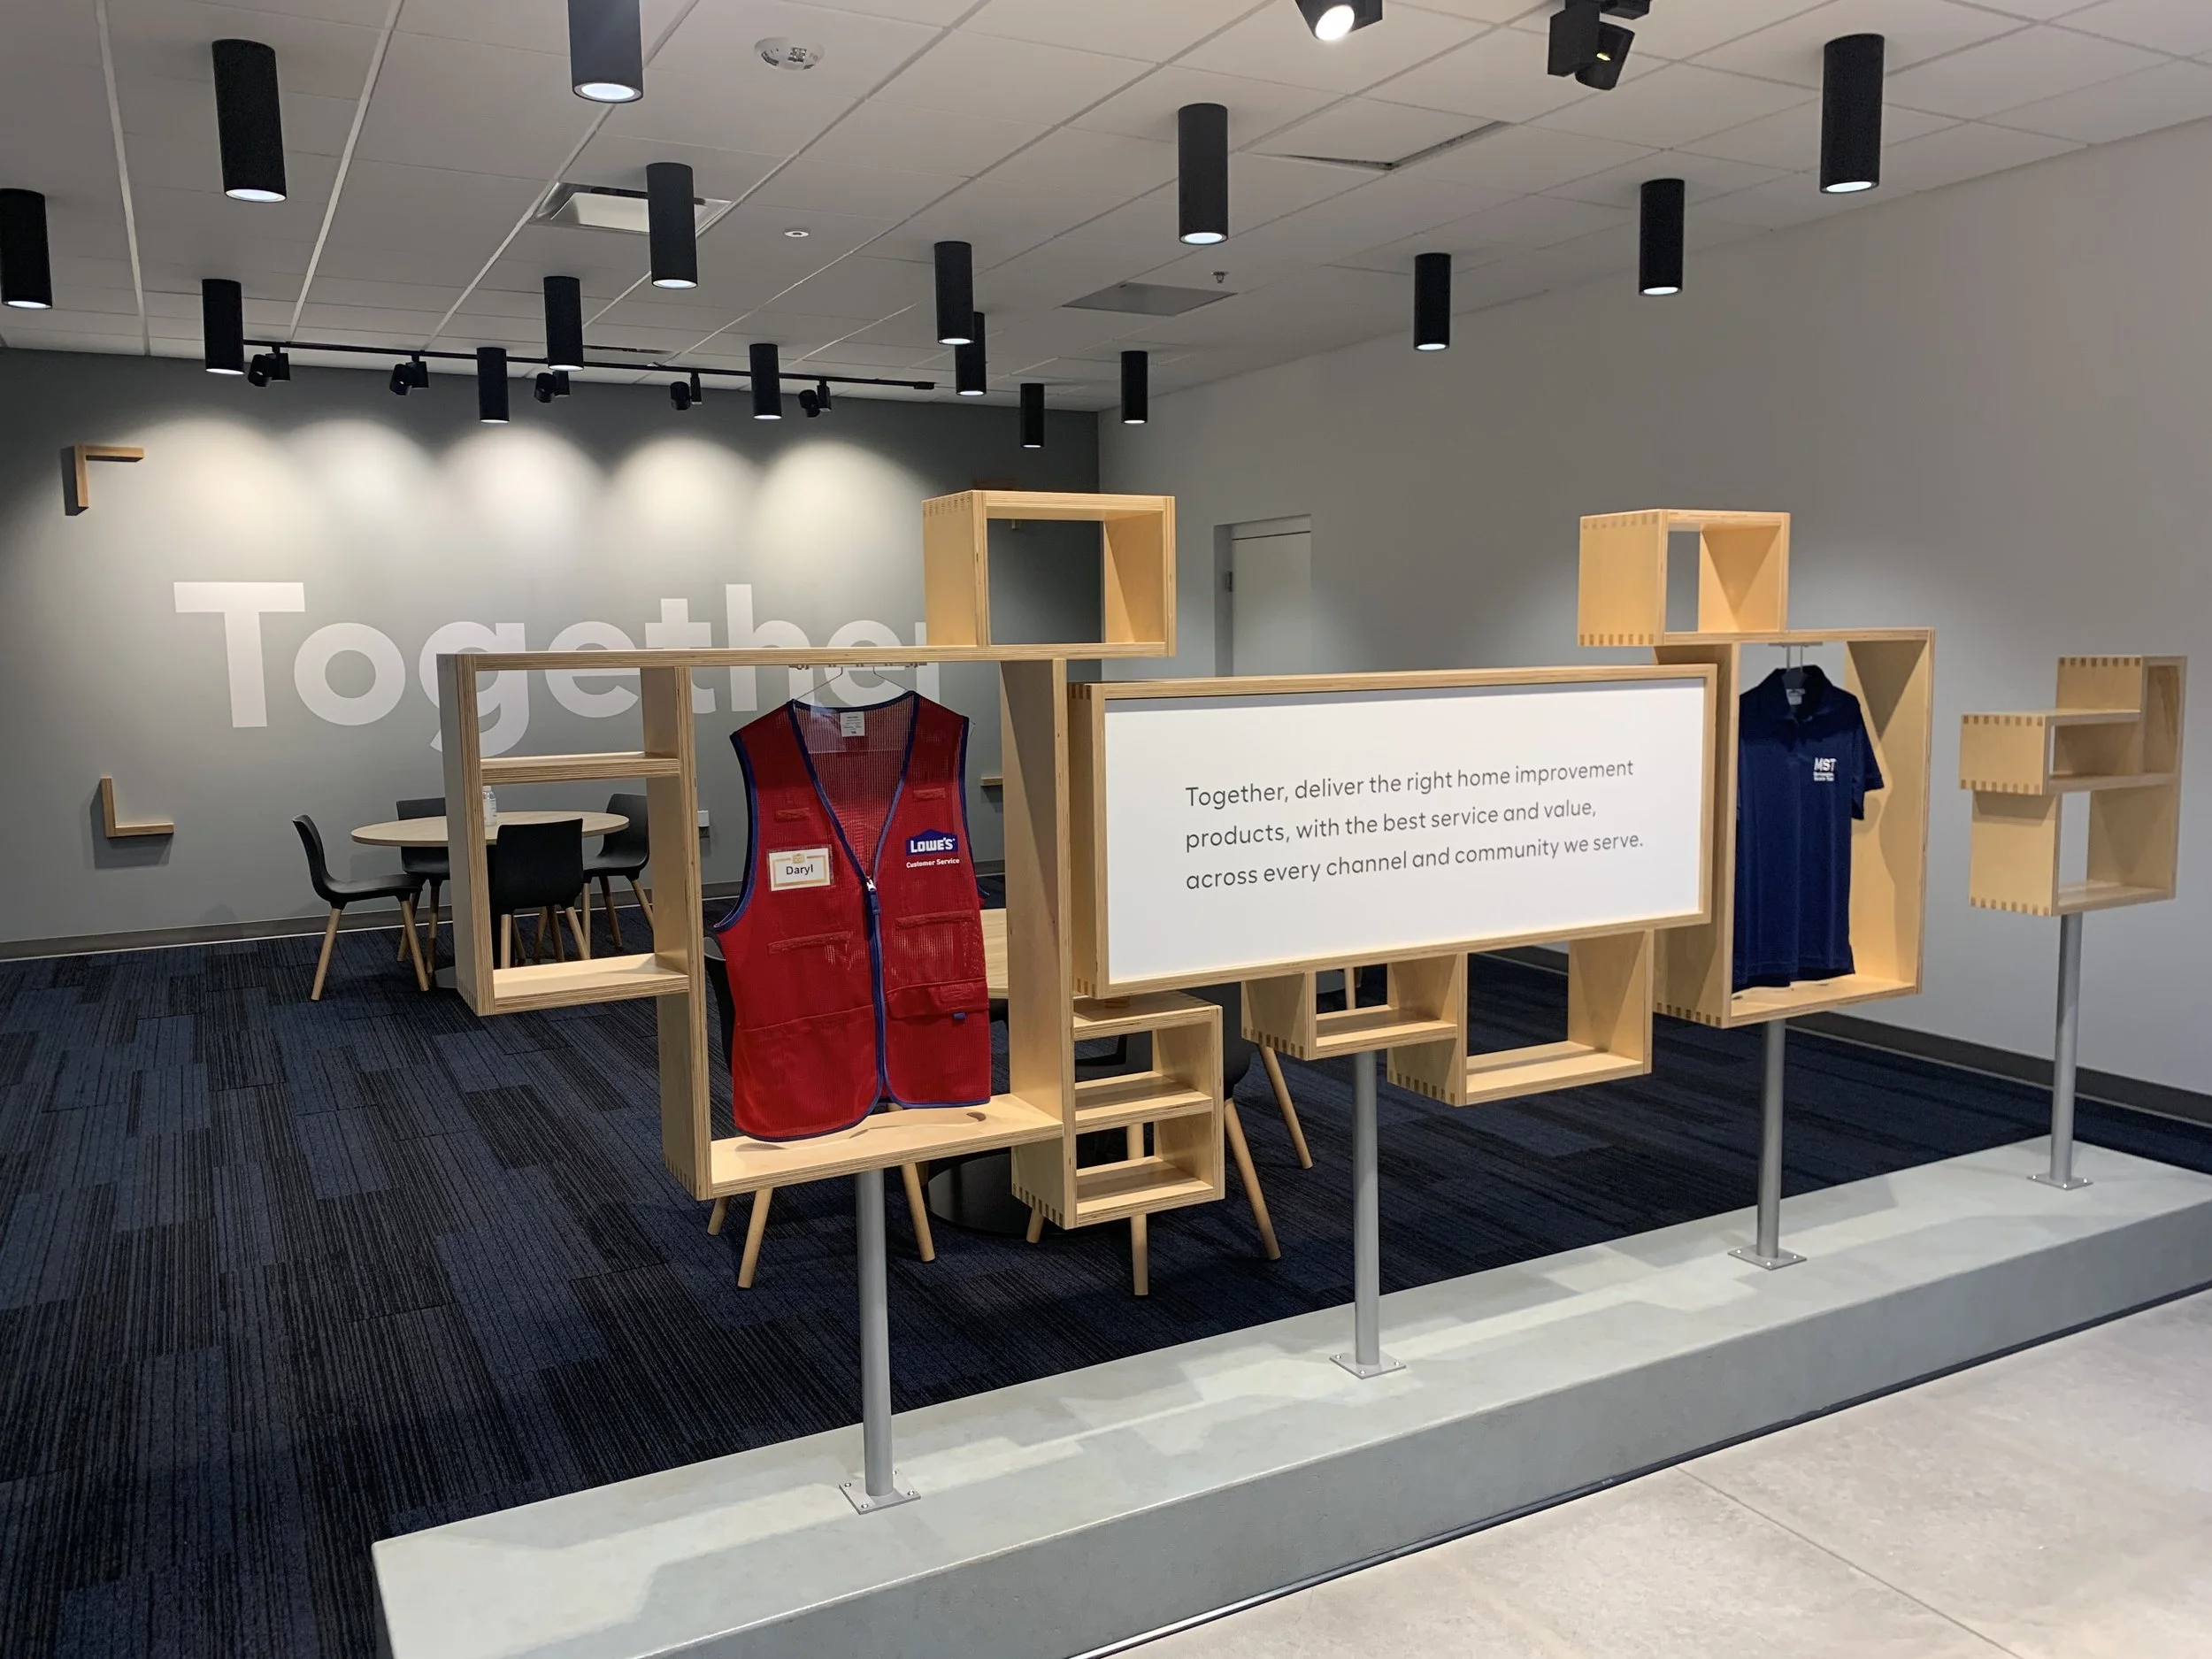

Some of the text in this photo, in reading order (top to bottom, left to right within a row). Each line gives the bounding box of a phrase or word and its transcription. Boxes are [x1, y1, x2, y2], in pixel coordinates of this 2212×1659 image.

[1814, 757, 1837, 772] MST
[1184, 760, 1634, 810] Together, deliver the right home improvement
[1186, 799, 1597, 855] products, with the best service and value,
[786, 864, 814, 876] Daryl
[906, 860, 935, 869] Customer
[1186, 834, 1644, 890] across every channel and community we serve.
